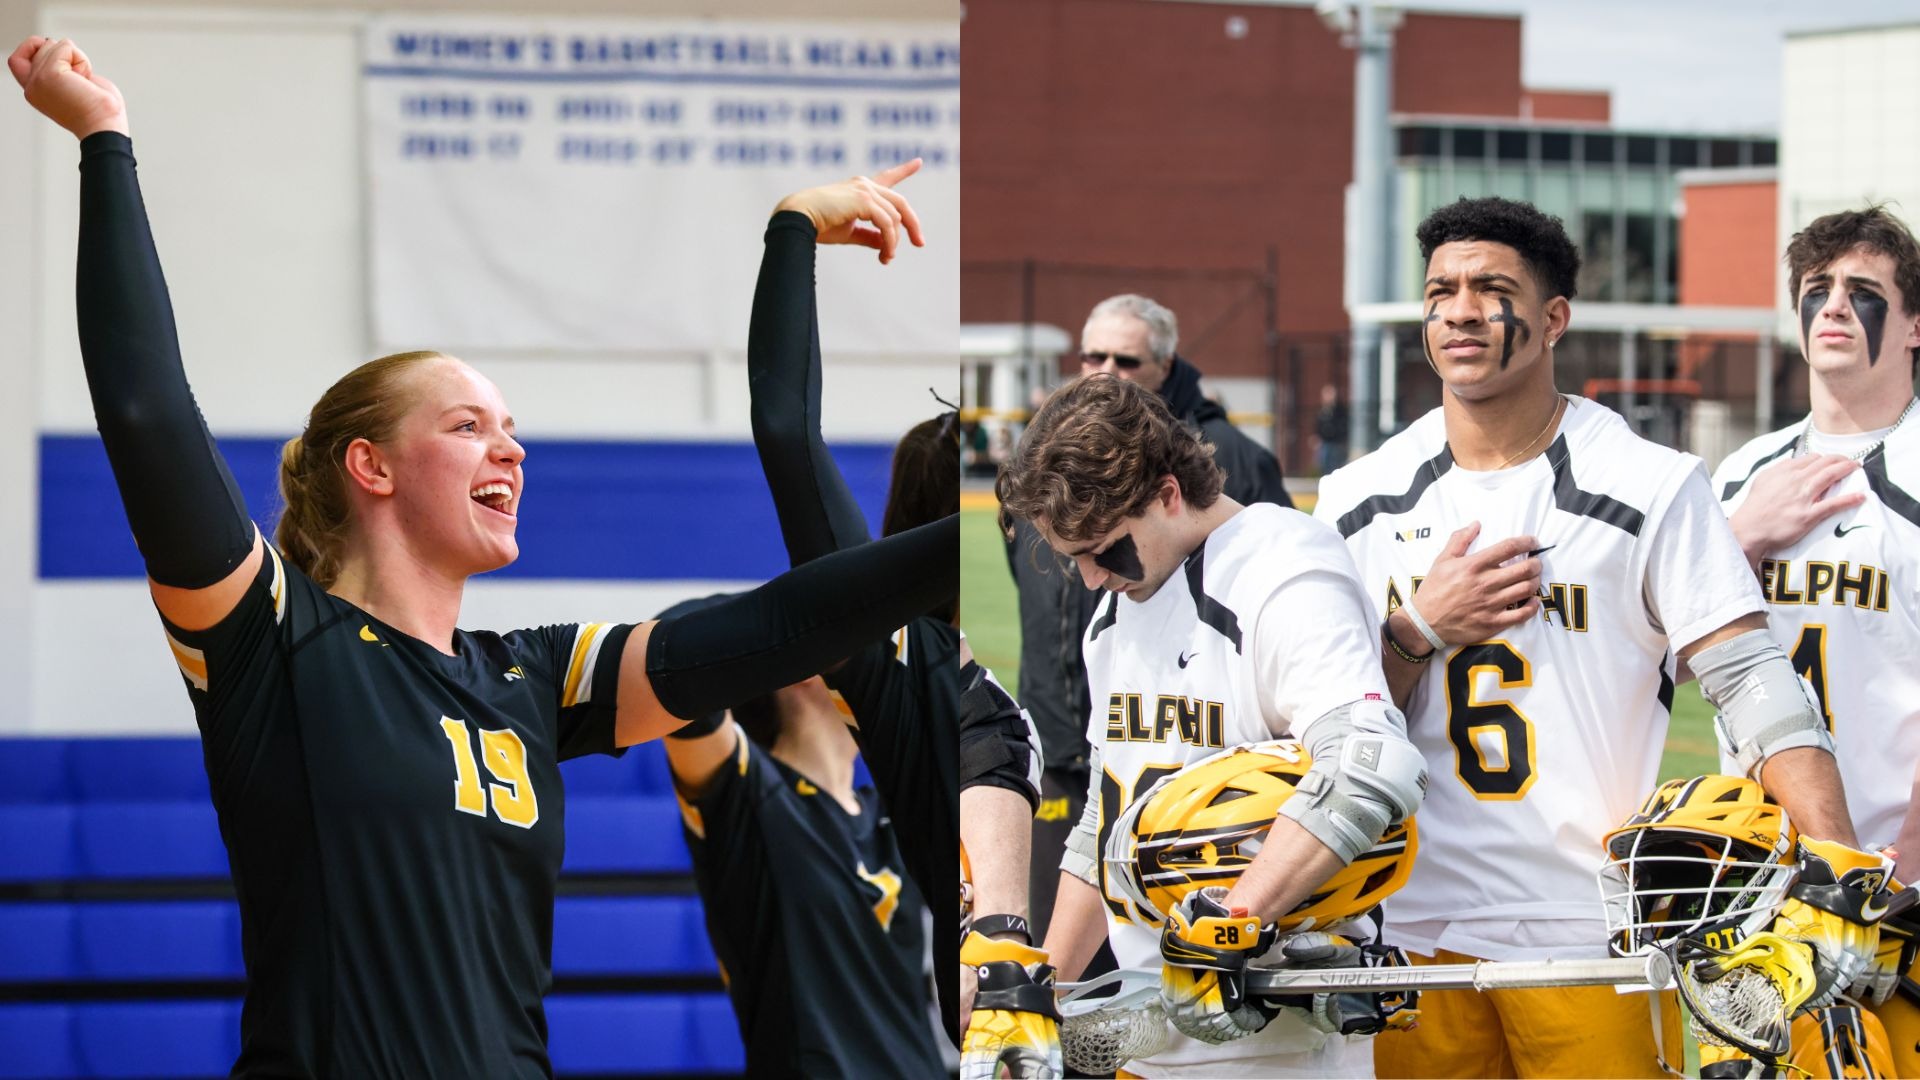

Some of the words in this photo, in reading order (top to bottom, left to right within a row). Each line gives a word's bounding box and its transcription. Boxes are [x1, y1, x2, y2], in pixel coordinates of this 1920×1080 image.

[391, 34, 555, 64] WOMEN'S
[569, 37, 791, 67] BASKETBALL
[806, 42, 893, 69] NCAA
[1444, 639, 1539, 801] 6
[440, 715, 539, 829] 19
[1214, 926, 1239, 944] 28
